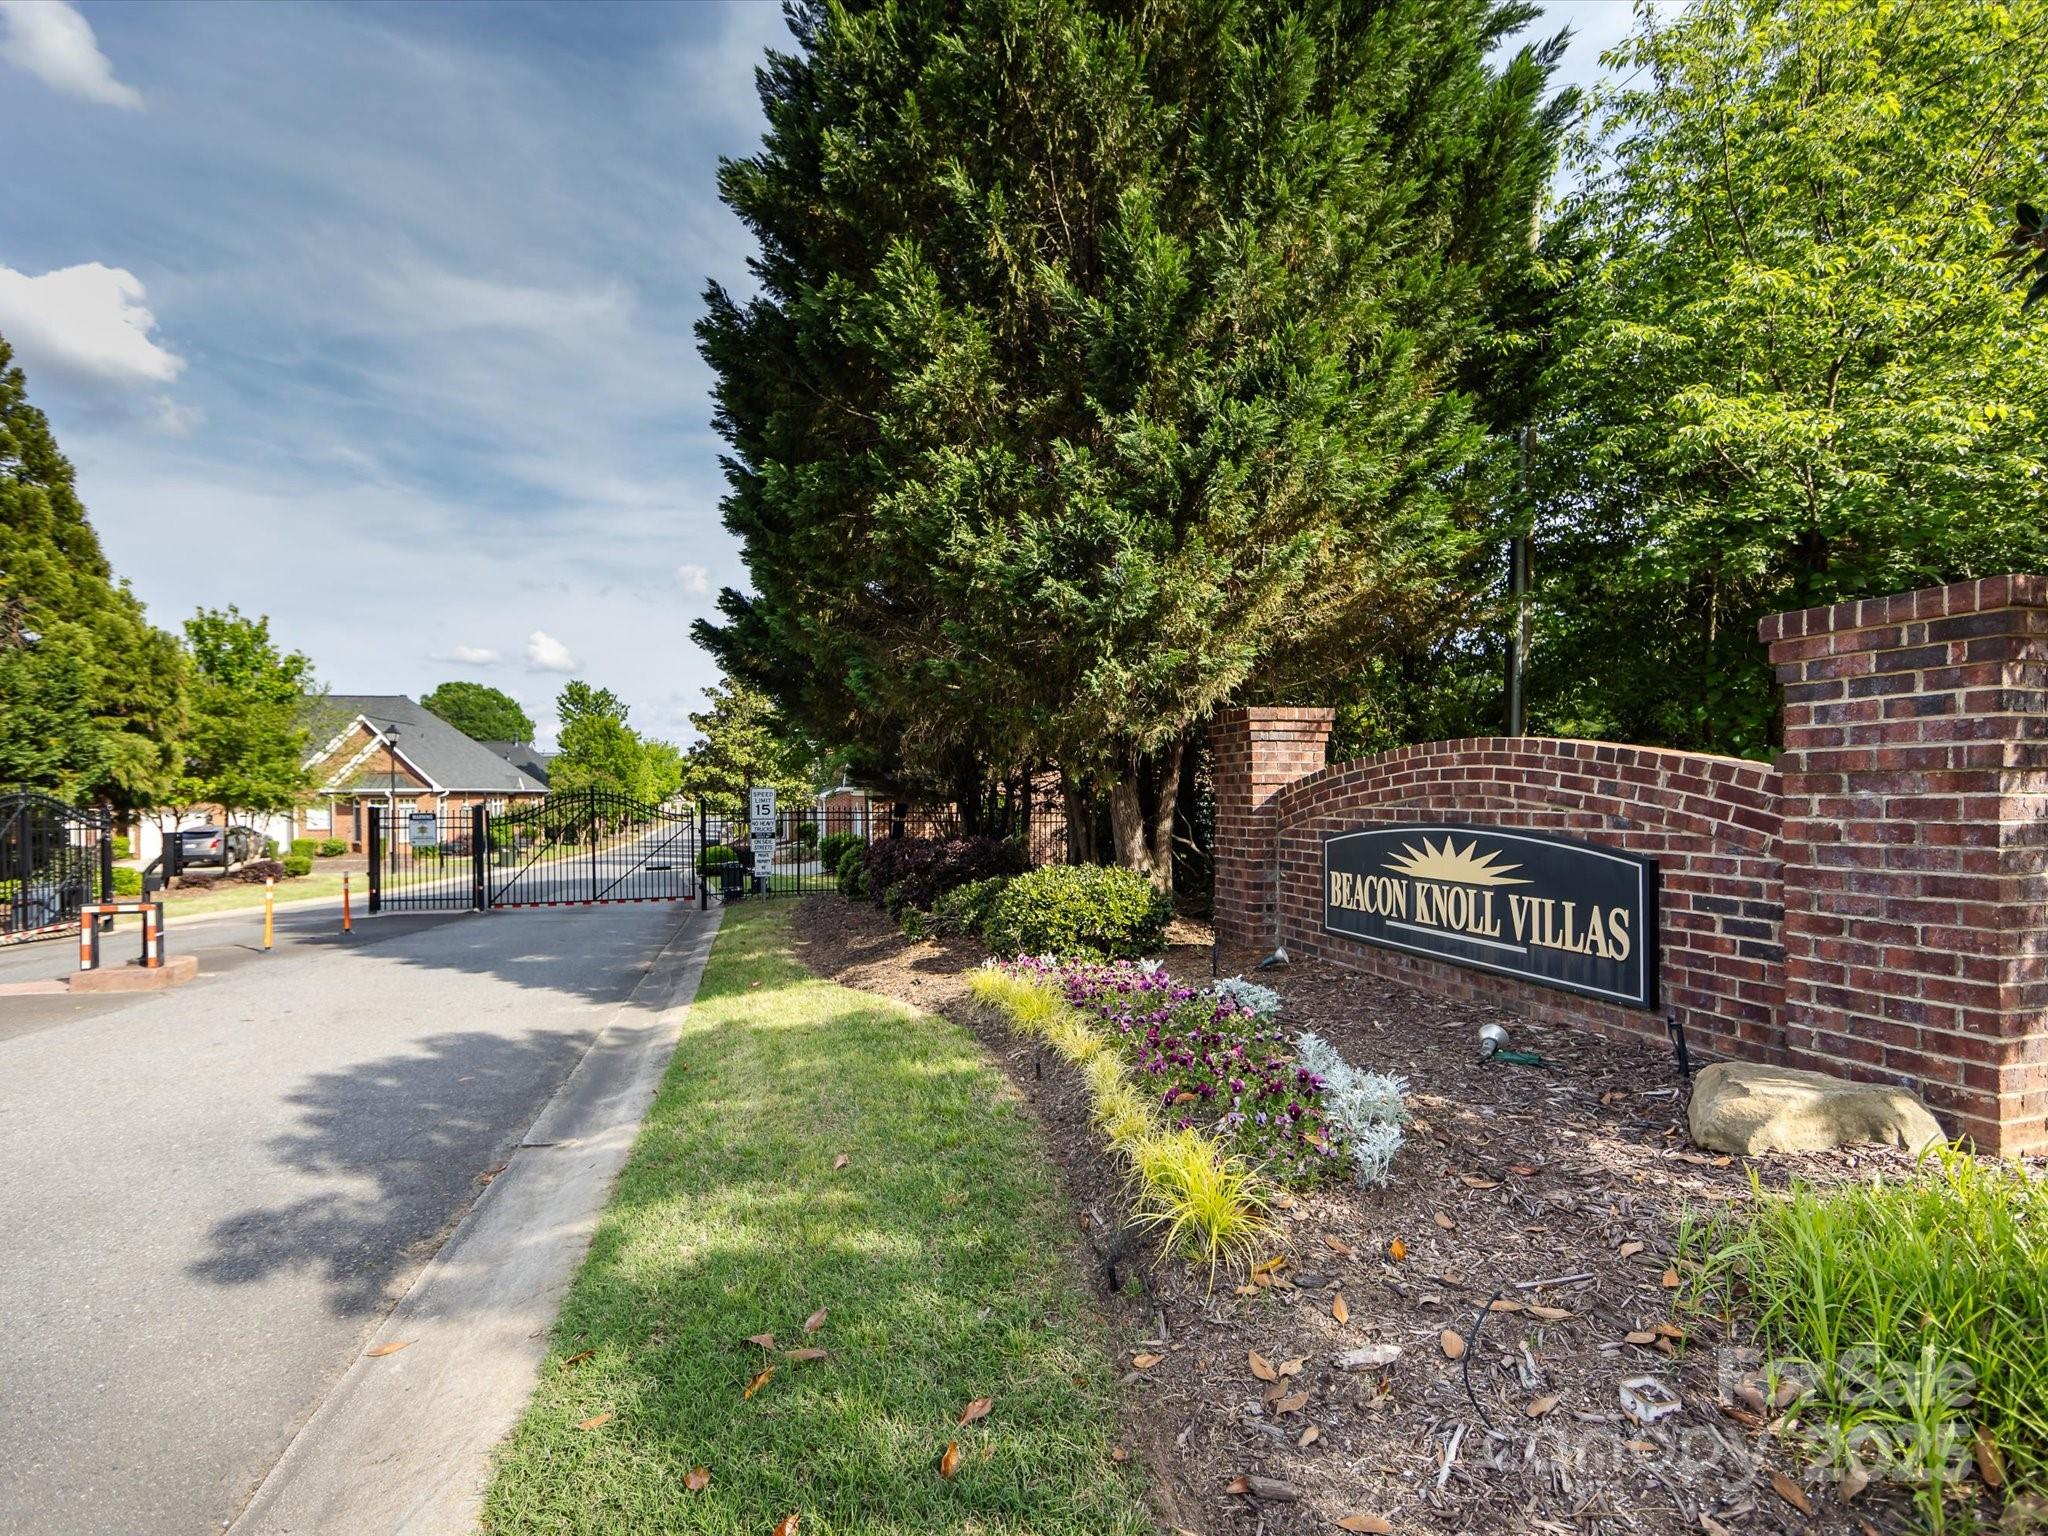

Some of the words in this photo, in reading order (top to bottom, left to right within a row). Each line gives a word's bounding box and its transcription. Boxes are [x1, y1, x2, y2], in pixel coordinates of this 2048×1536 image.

[755, 804, 771, 815] 15
[1329, 870, 1408, 920] BEACON
[1415, 881, 1501, 938] KNOLL
[1508, 893, 1631, 962] VILLAS
